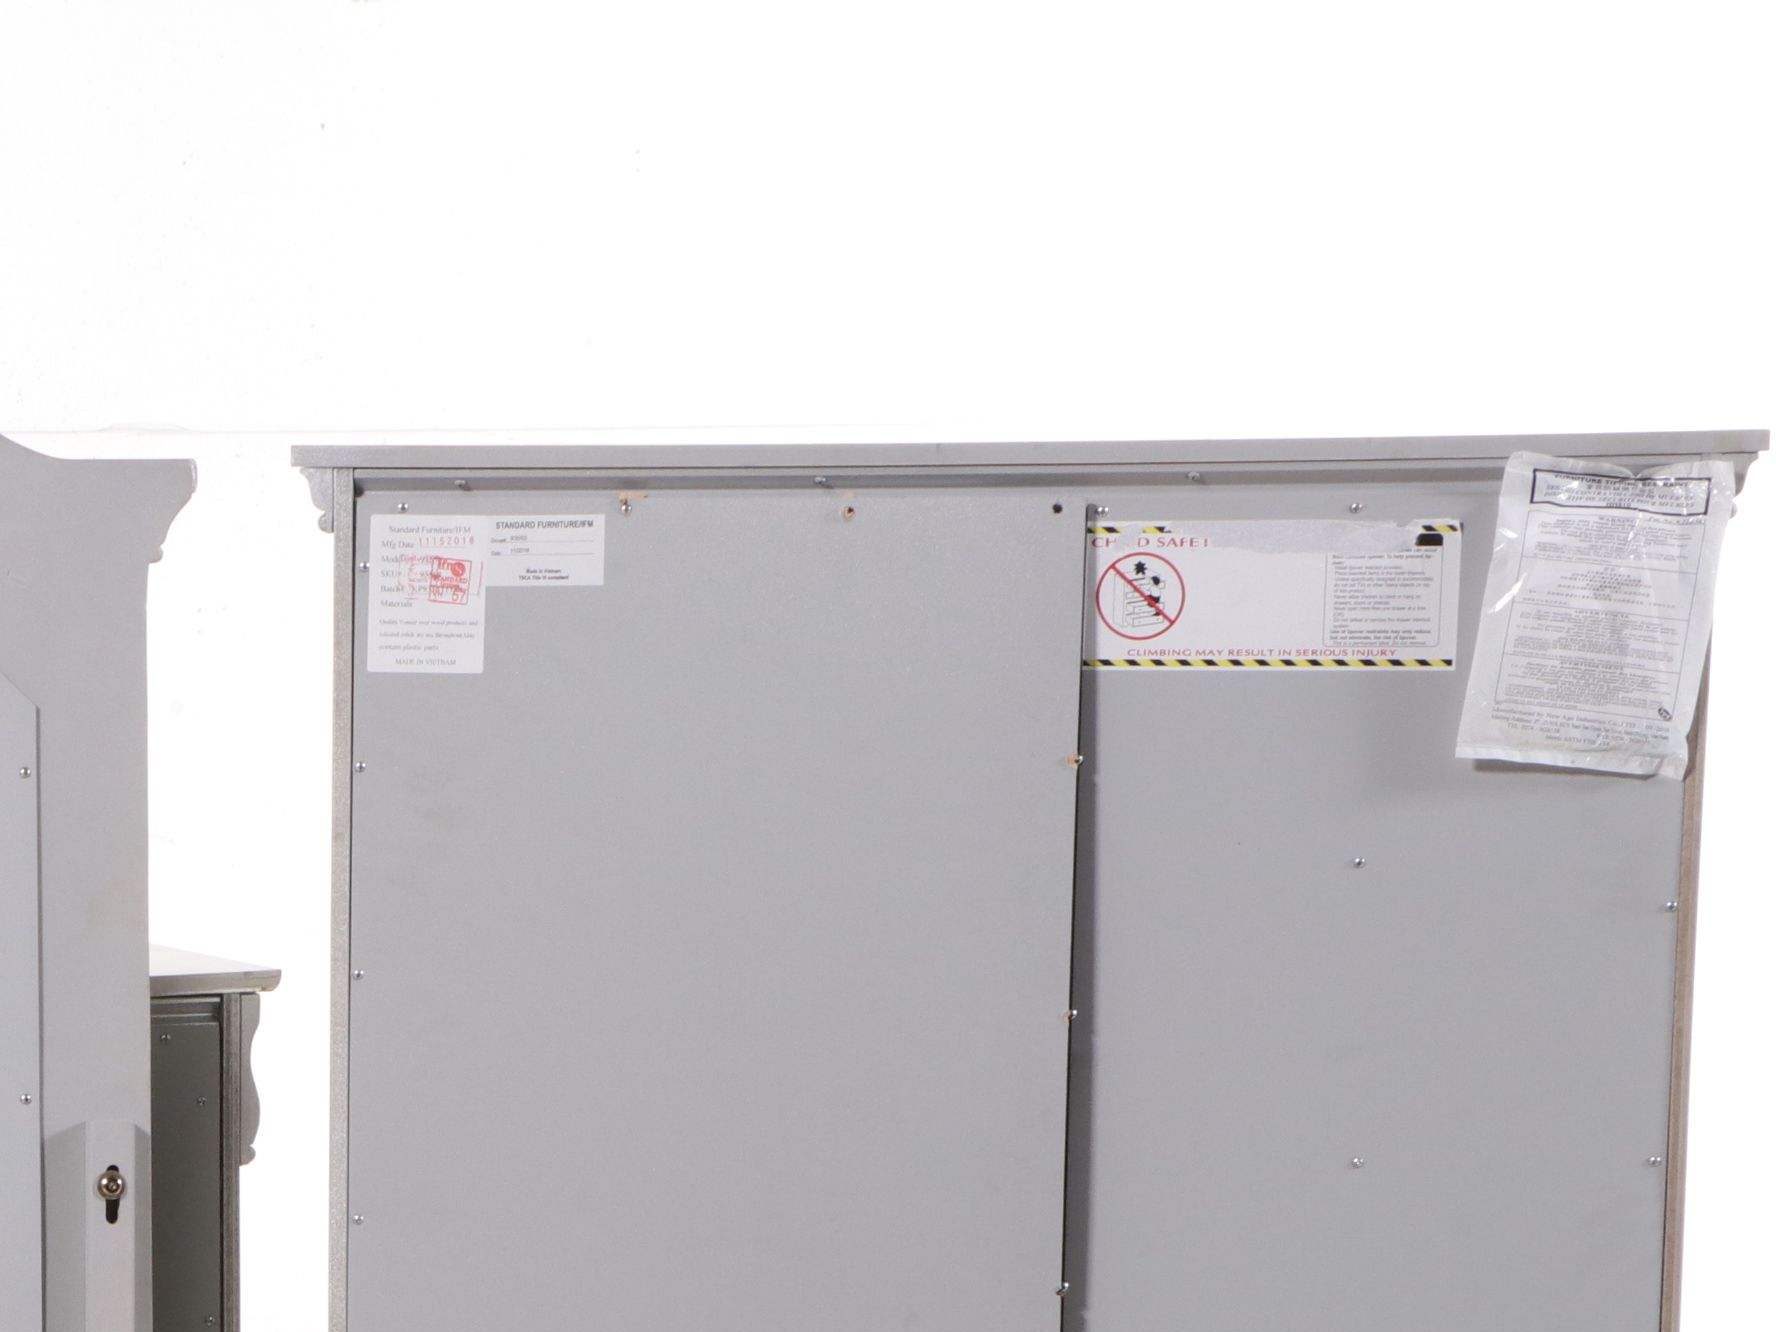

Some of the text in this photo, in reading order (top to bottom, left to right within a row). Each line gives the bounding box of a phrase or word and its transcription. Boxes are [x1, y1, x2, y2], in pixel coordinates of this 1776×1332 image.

[496, 520, 593, 529] STANDARD FURNITURE/IFM
[389, 526, 420, 534] Standard
[382, 540, 396, 549] Mfg
[1127, 648, 1396, 657] CLIMBING MAY RESULT IN SERIOUS INJURY
